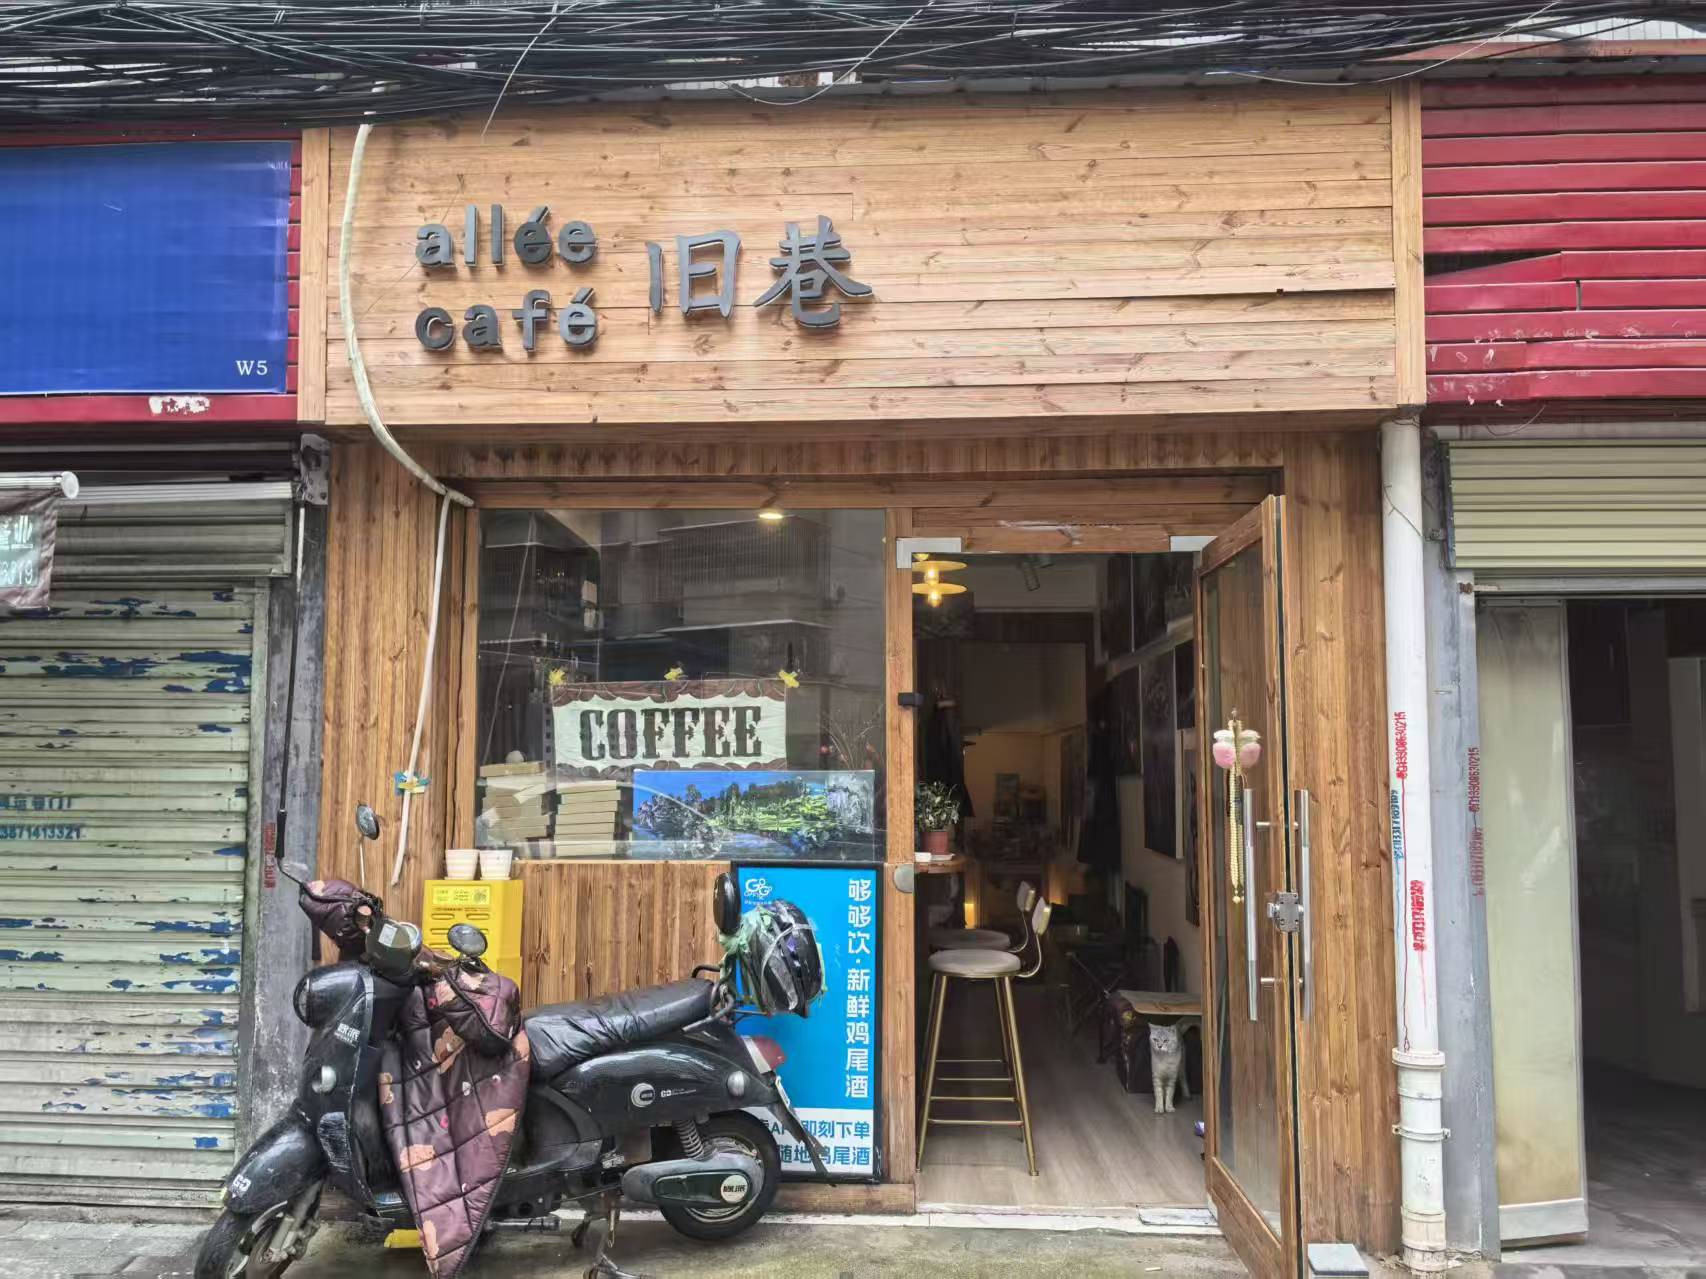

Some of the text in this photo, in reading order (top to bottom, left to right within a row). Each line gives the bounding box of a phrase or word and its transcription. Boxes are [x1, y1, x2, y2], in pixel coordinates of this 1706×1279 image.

[414, 203, 598, 267] allée
[645, 214, 874, 328] 旧巷
[414, 287, 598, 351] café
[235, 360, 268, 376] W5
[580, 705, 762, 761] COFFEE
